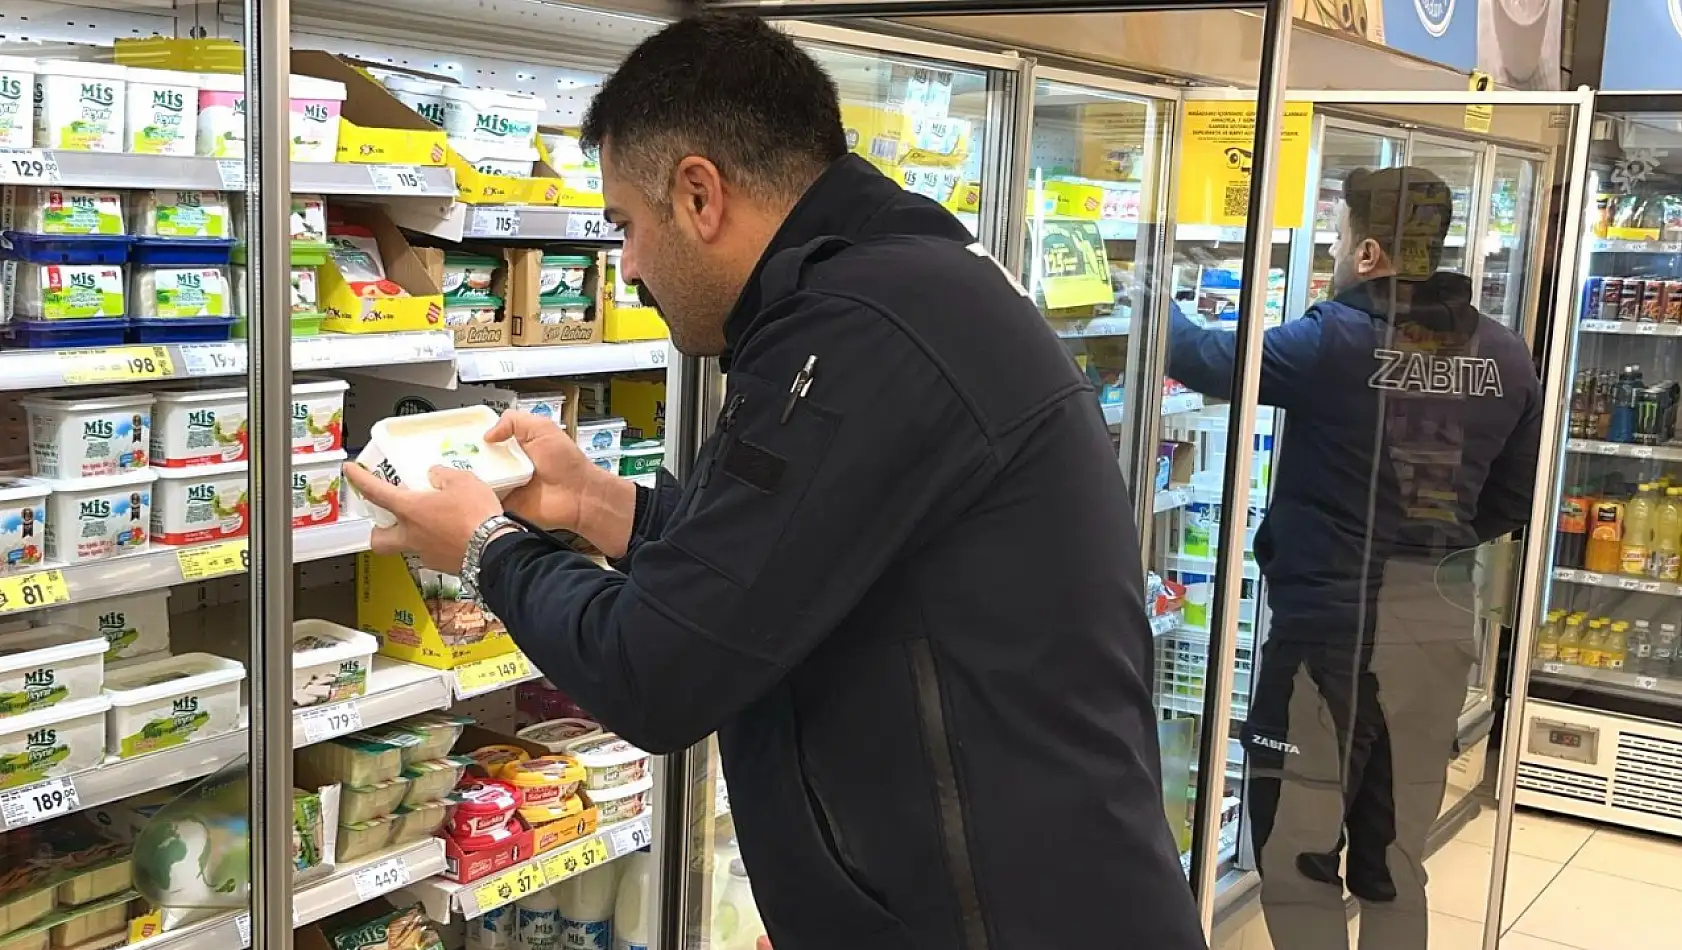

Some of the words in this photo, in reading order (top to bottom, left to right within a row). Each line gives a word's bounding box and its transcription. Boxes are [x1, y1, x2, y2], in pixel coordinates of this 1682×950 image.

[12, 161, 43, 177] 129
[397, 173, 417, 187] 115
[495, 217, 511, 231] 115
[584, 220, 600, 236] 94
[128, 358, 155, 374] 198
[1368, 348, 1503, 397] ZABITA
[22, 584, 44, 604] 81
[496, 662, 517, 677] 149
[328, 714, 348, 730] 179
[1251, 734, 1300, 755] ZABITA
[33, 790, 62, 812] 189
[632, 830, 646, 846] 91
[582, 850, 595, 865] 37
[375, 869, 398, 887] 449
[518, 876, 531, 892] 37
